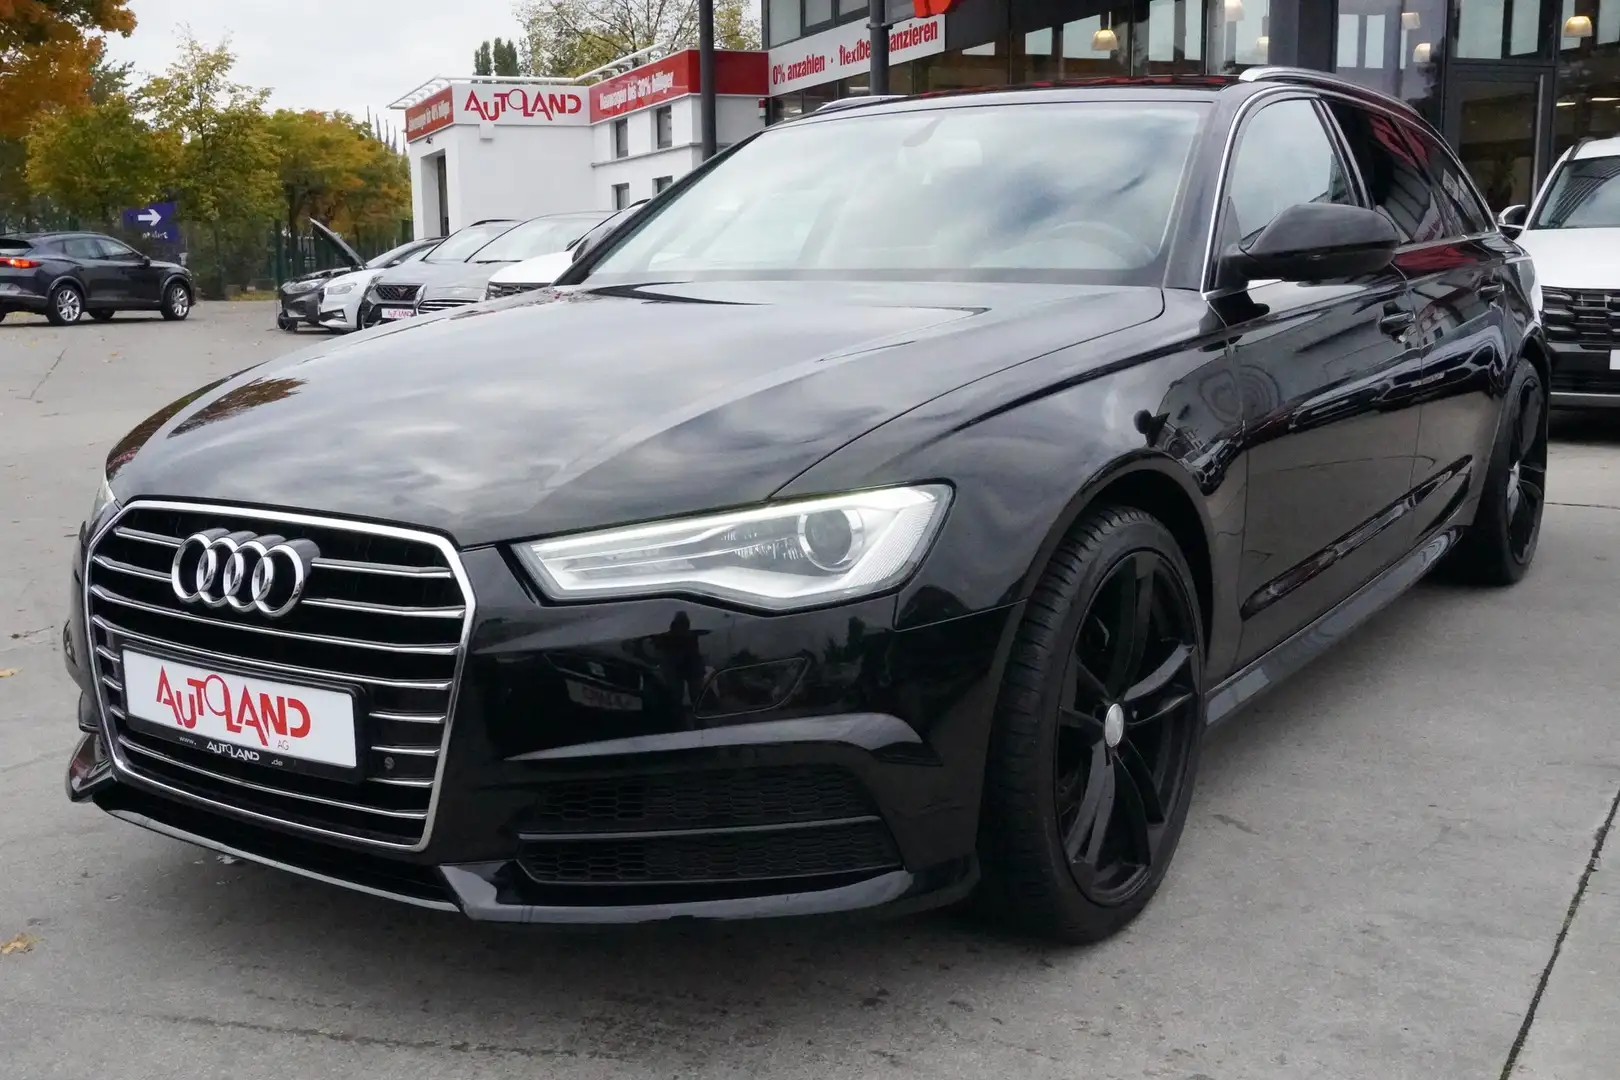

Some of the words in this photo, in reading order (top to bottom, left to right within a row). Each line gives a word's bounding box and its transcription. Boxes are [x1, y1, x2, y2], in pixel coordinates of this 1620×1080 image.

[772, 63, 786, 86] 0%
[787, 52, 826, 81] anzahlen
[838, 38, 871, 67] flexibe
[888, 20, 938, 53] anzieren
[463, 88, 582, 122] AUTOLAND
[155, 664, 312, 747] AUTOLAND
[205, 740, 260, 761] AUTOLAND
[277, 739, 290, 751] AG
